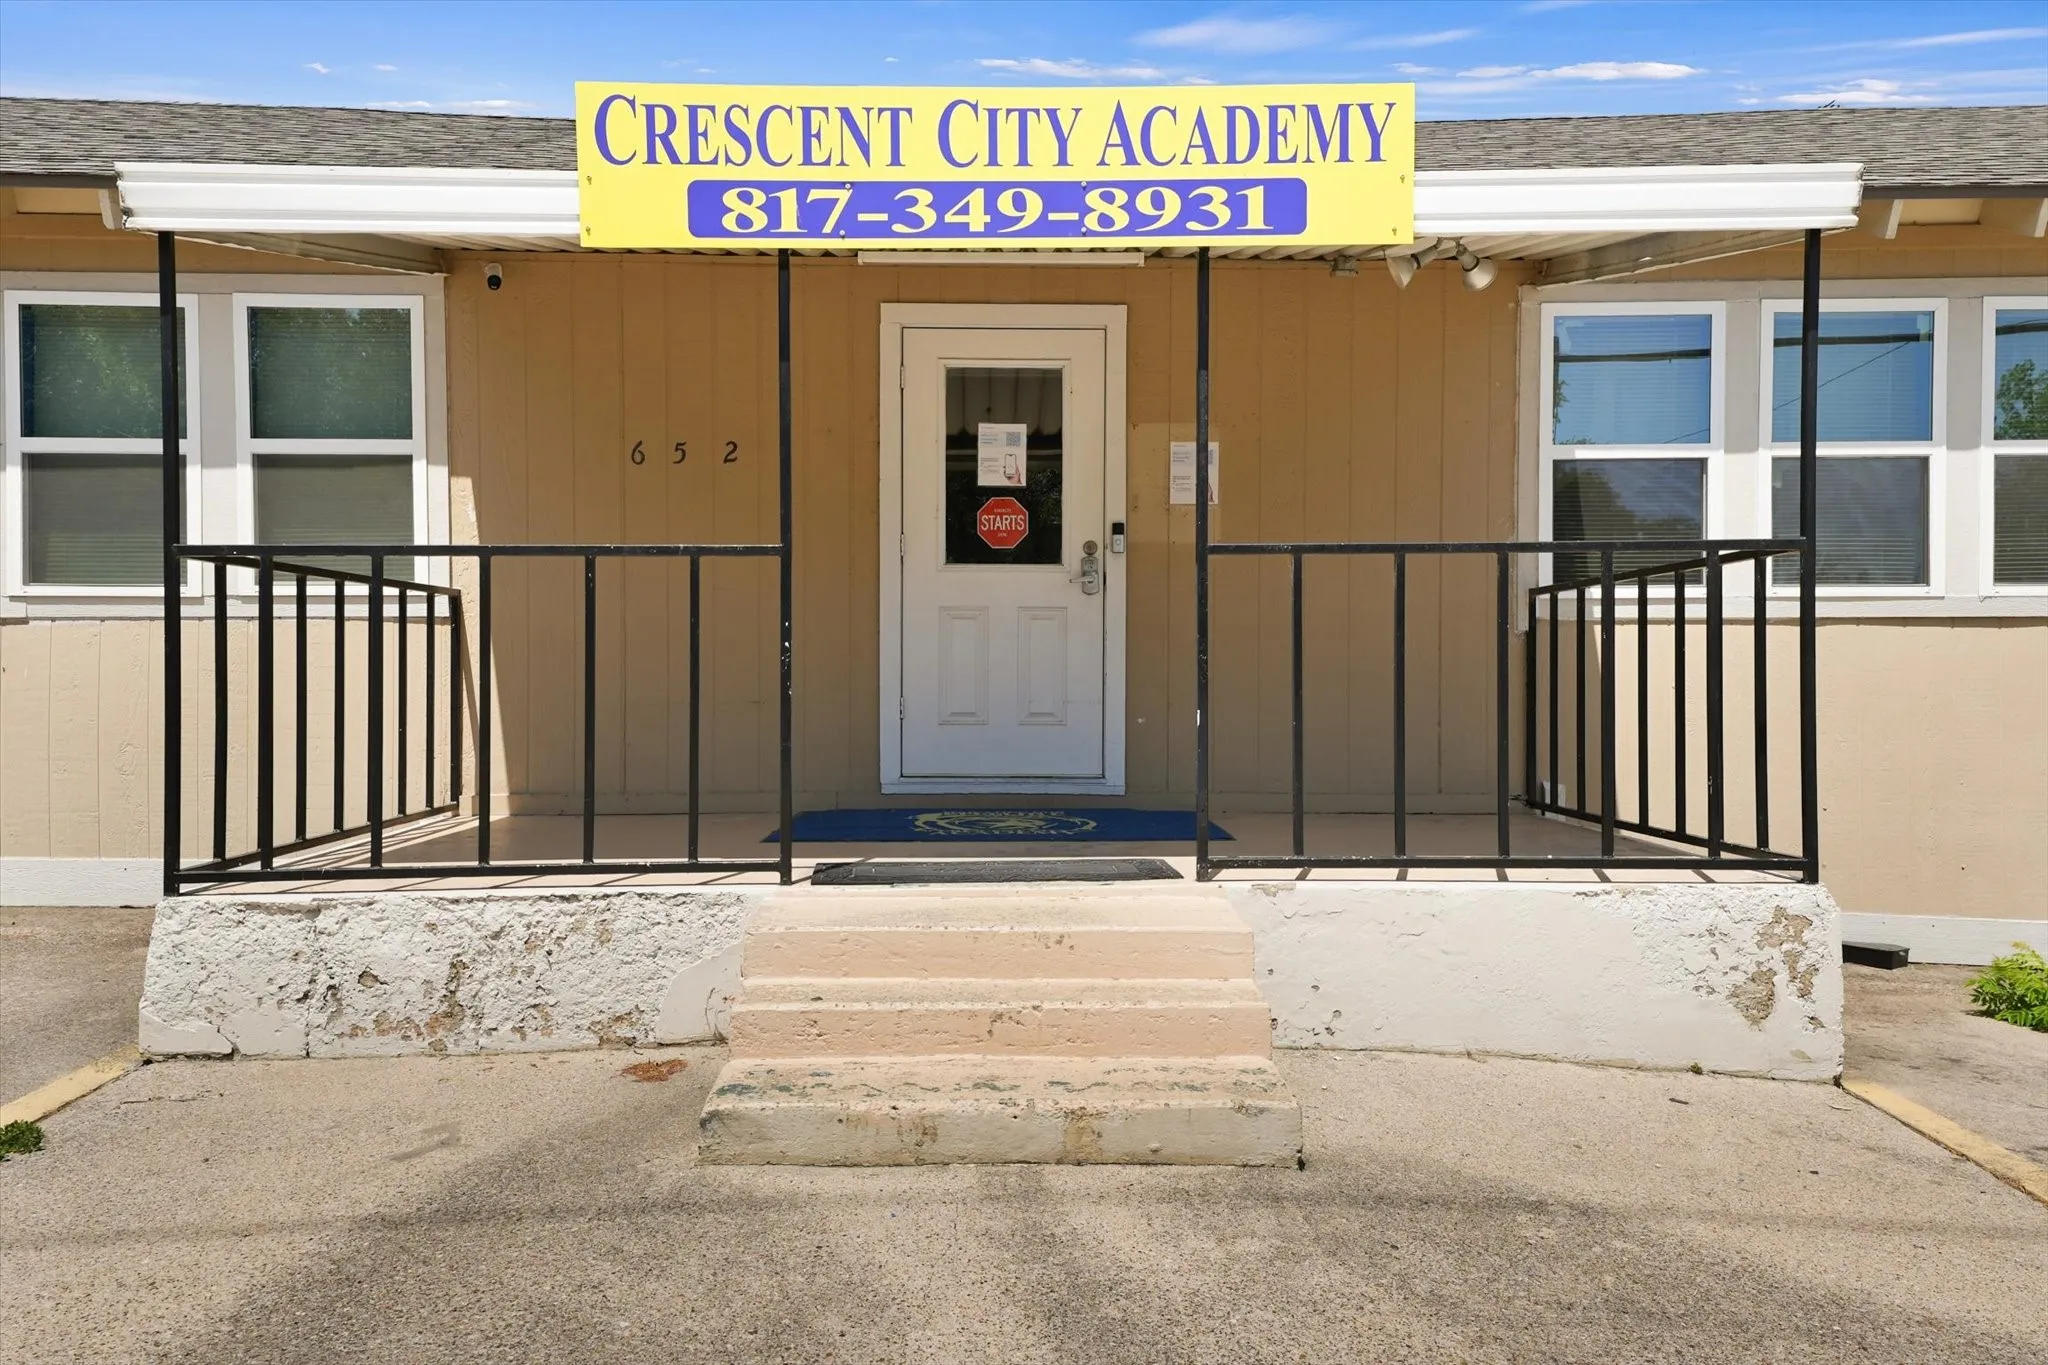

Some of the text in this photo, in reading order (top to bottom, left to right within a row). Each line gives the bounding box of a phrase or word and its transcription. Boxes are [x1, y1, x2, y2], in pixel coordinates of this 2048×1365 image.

[593, 94, 1398, 168] CRESCENT CITY ACADEMY
[720, 185, 1275, 235] 817-349-8931
[980, 514, 1025, 531] STARTS
